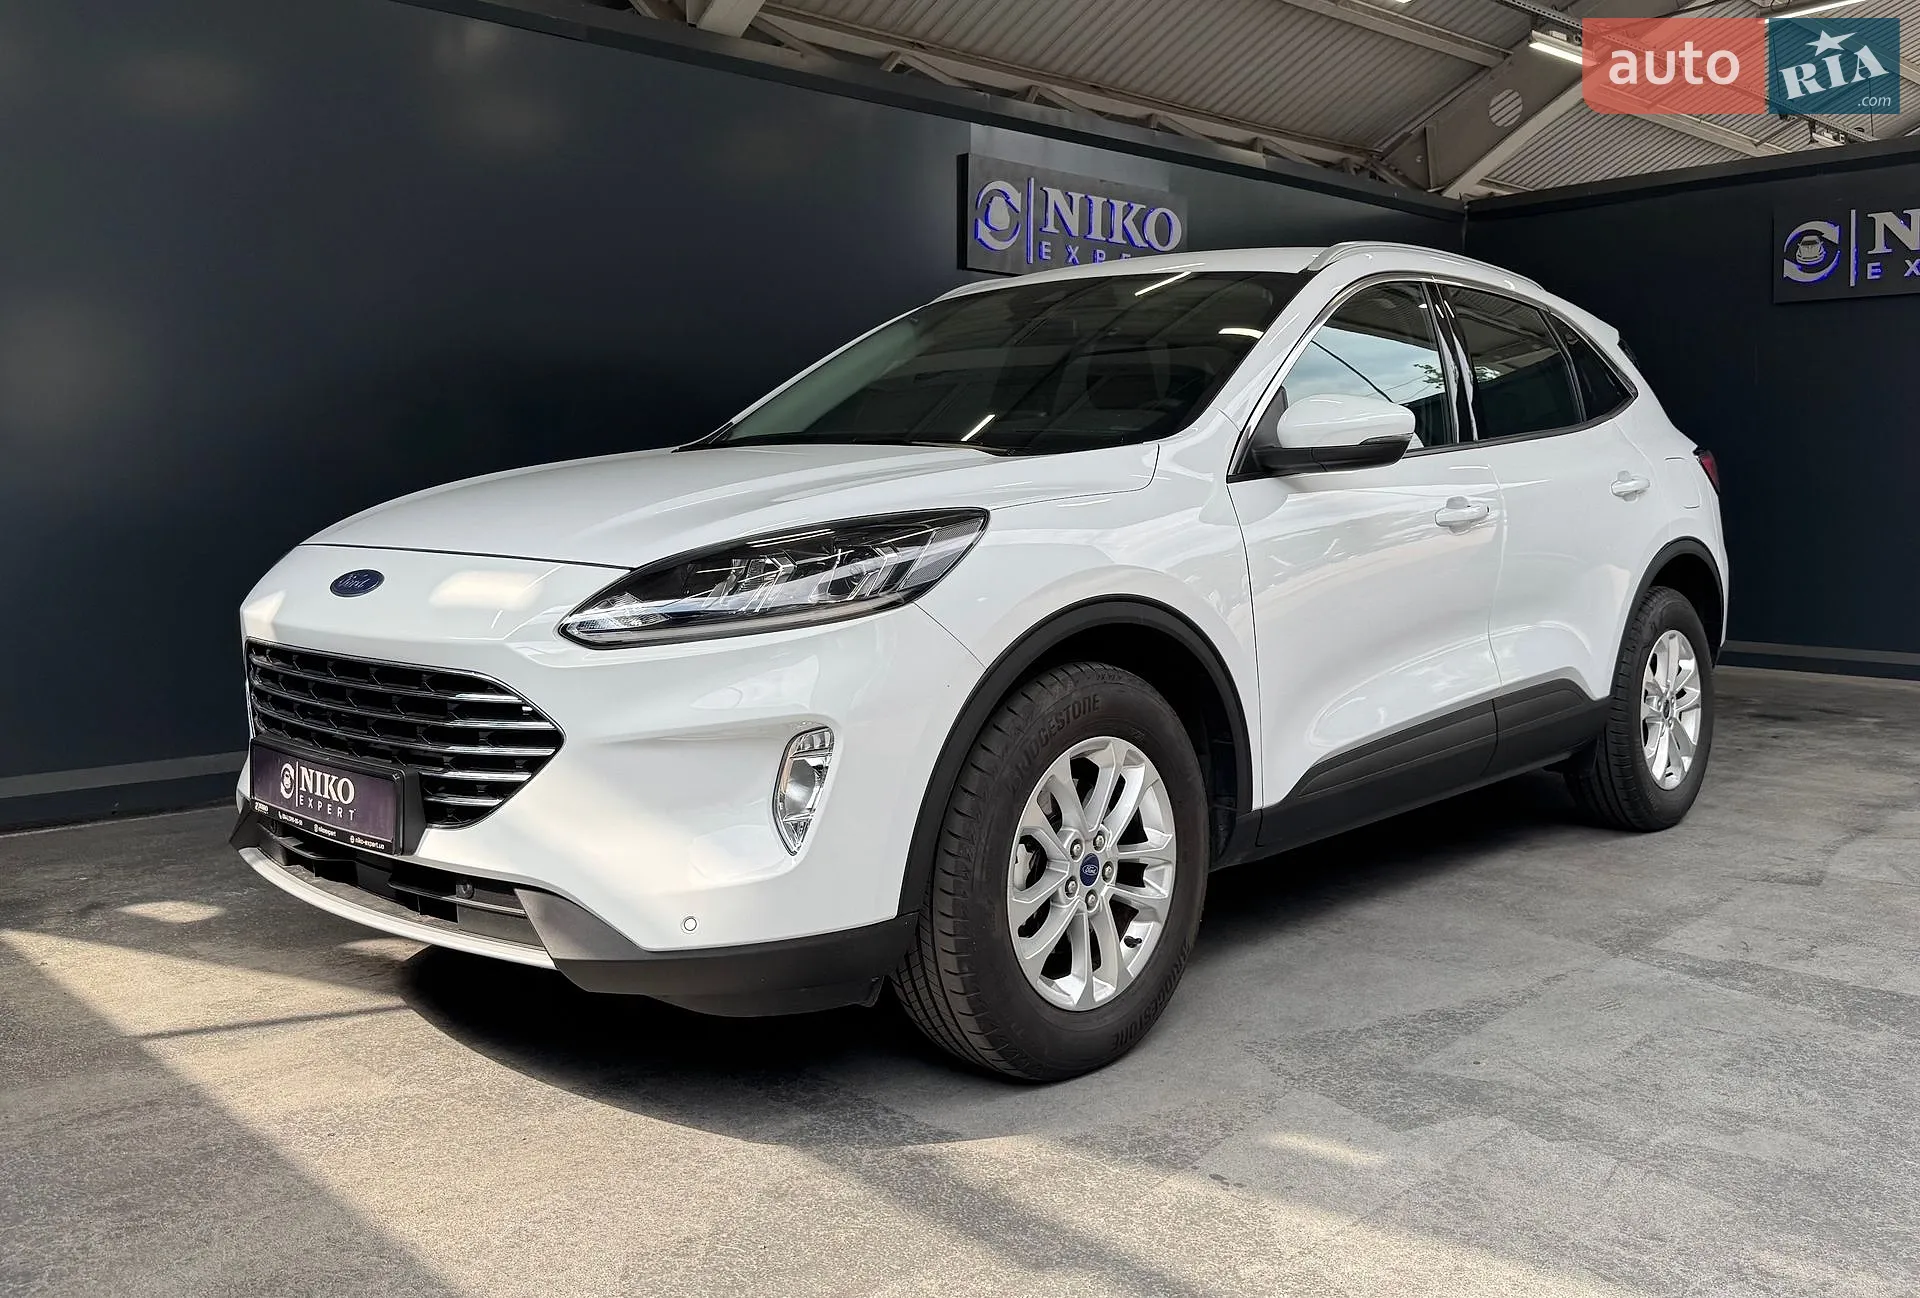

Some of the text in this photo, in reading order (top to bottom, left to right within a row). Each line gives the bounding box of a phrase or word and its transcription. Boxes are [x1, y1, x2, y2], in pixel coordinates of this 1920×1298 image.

[1039, 186, 1182, 252] NIKO
[300, 766, 355, 804] NIKO
[299, 794, 355, 821] EXPERT
